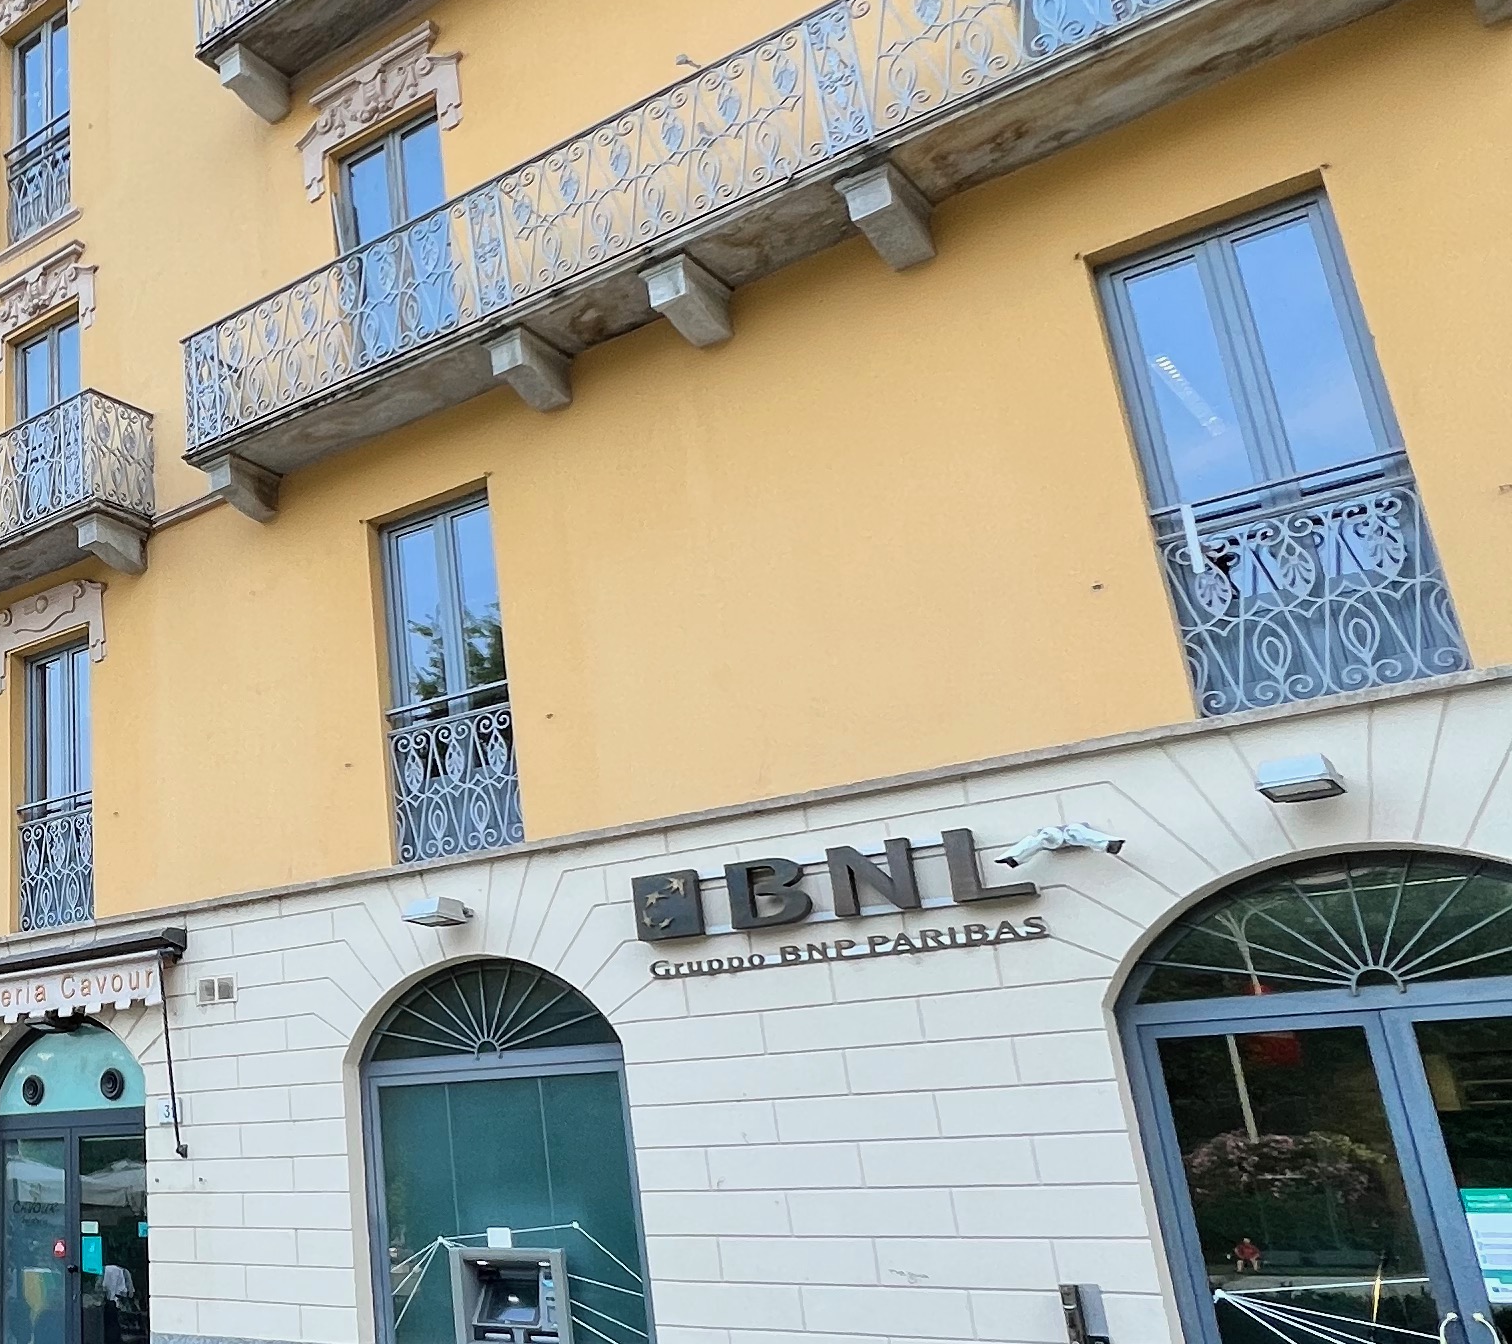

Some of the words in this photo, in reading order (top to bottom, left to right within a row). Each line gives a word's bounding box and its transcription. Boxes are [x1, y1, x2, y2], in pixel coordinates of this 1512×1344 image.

[724, 827, 1040, 930] BNL
[650, 953, 766, 980] Gruppo
[779, 939, 856, 965] BNP
[867, 916, 1050, 955] PARIBAS
[61, 968, 154, 1000] Cavour
